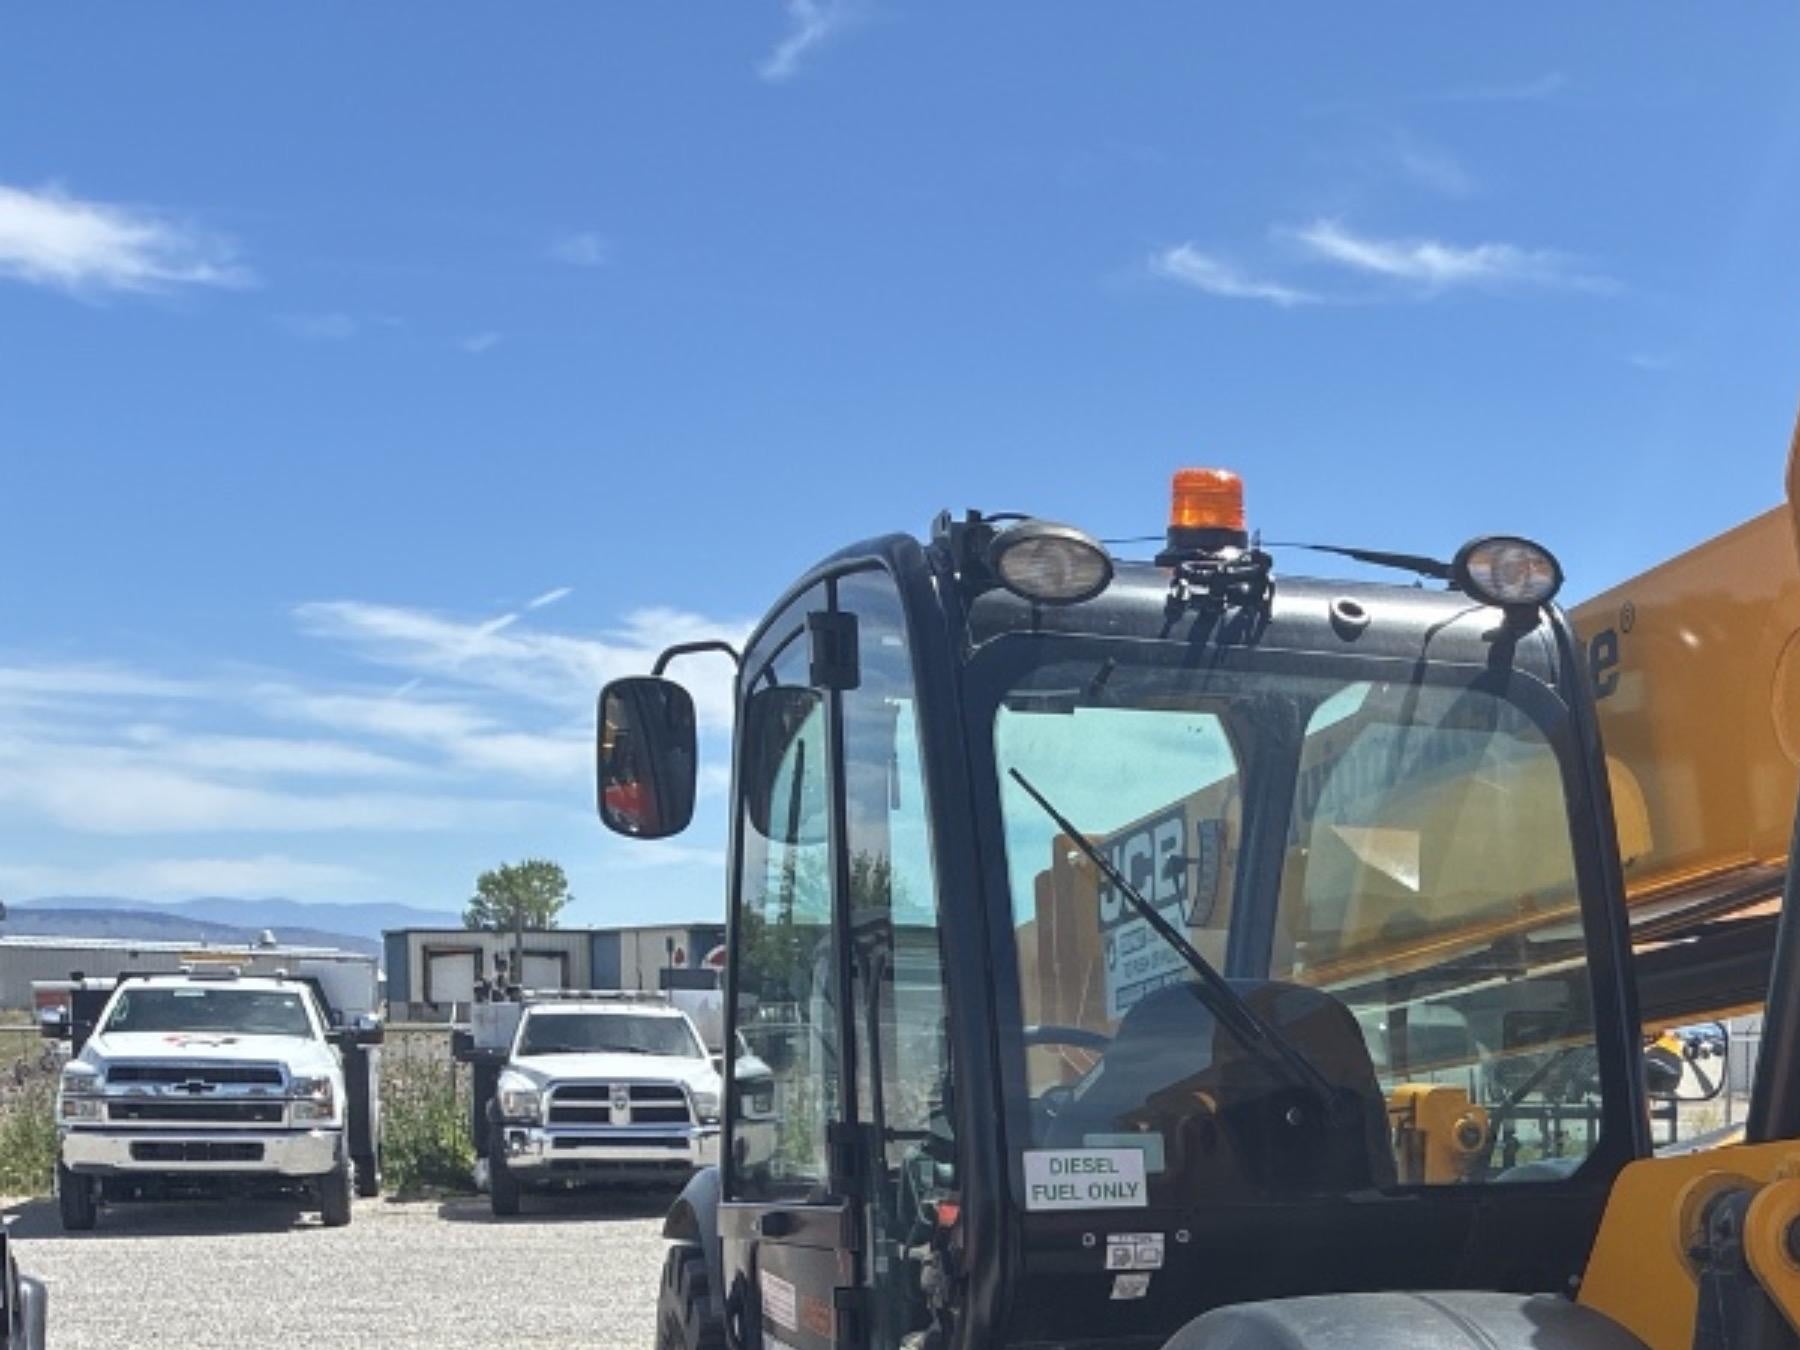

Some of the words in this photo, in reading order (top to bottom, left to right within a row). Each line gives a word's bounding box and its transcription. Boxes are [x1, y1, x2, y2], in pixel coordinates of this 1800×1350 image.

[1049, 1157, 1120, 1176] DIESEL
[1031, 1185, 1083, 1201] FUEL
[1088, 1182, 1139, 1199] ONLY
